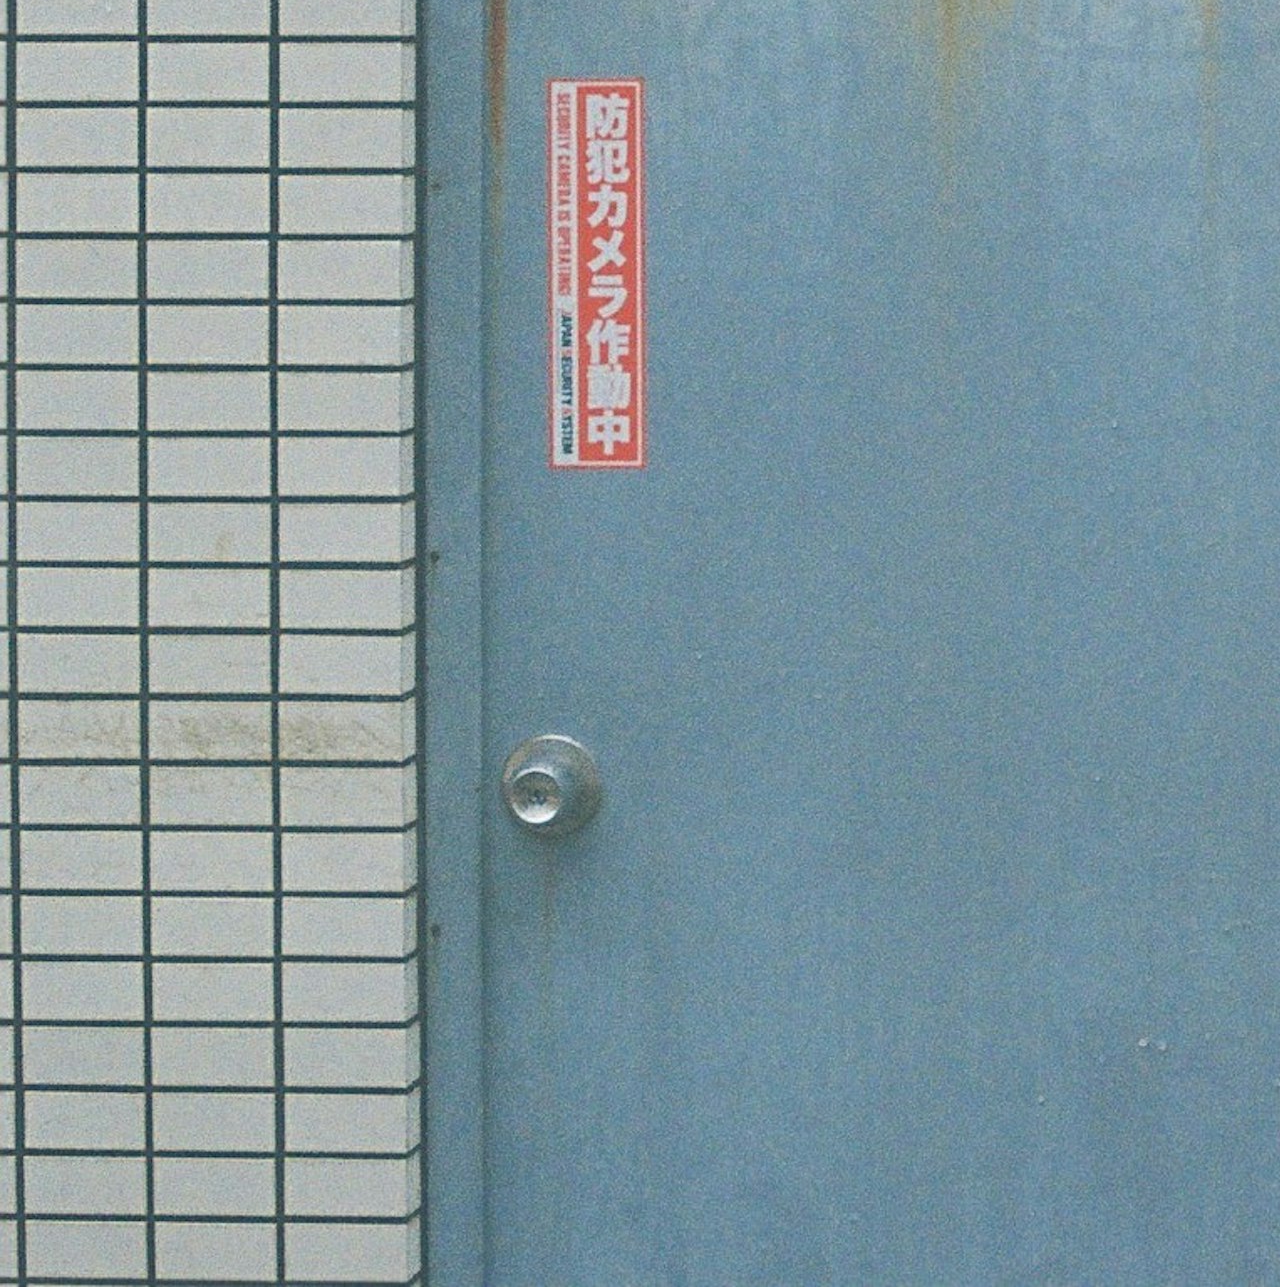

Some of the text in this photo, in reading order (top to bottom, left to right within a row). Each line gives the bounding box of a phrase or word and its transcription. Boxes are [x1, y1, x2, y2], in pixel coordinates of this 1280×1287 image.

[558, 92, 572, 297] SECURITY CAMERA IS OPERATING
[584, 92, 632, 457] 防犯カメラ作動中
[562, 348, 574, 405] SECURITY
[562, 408, 574, 455] SYSTEM
